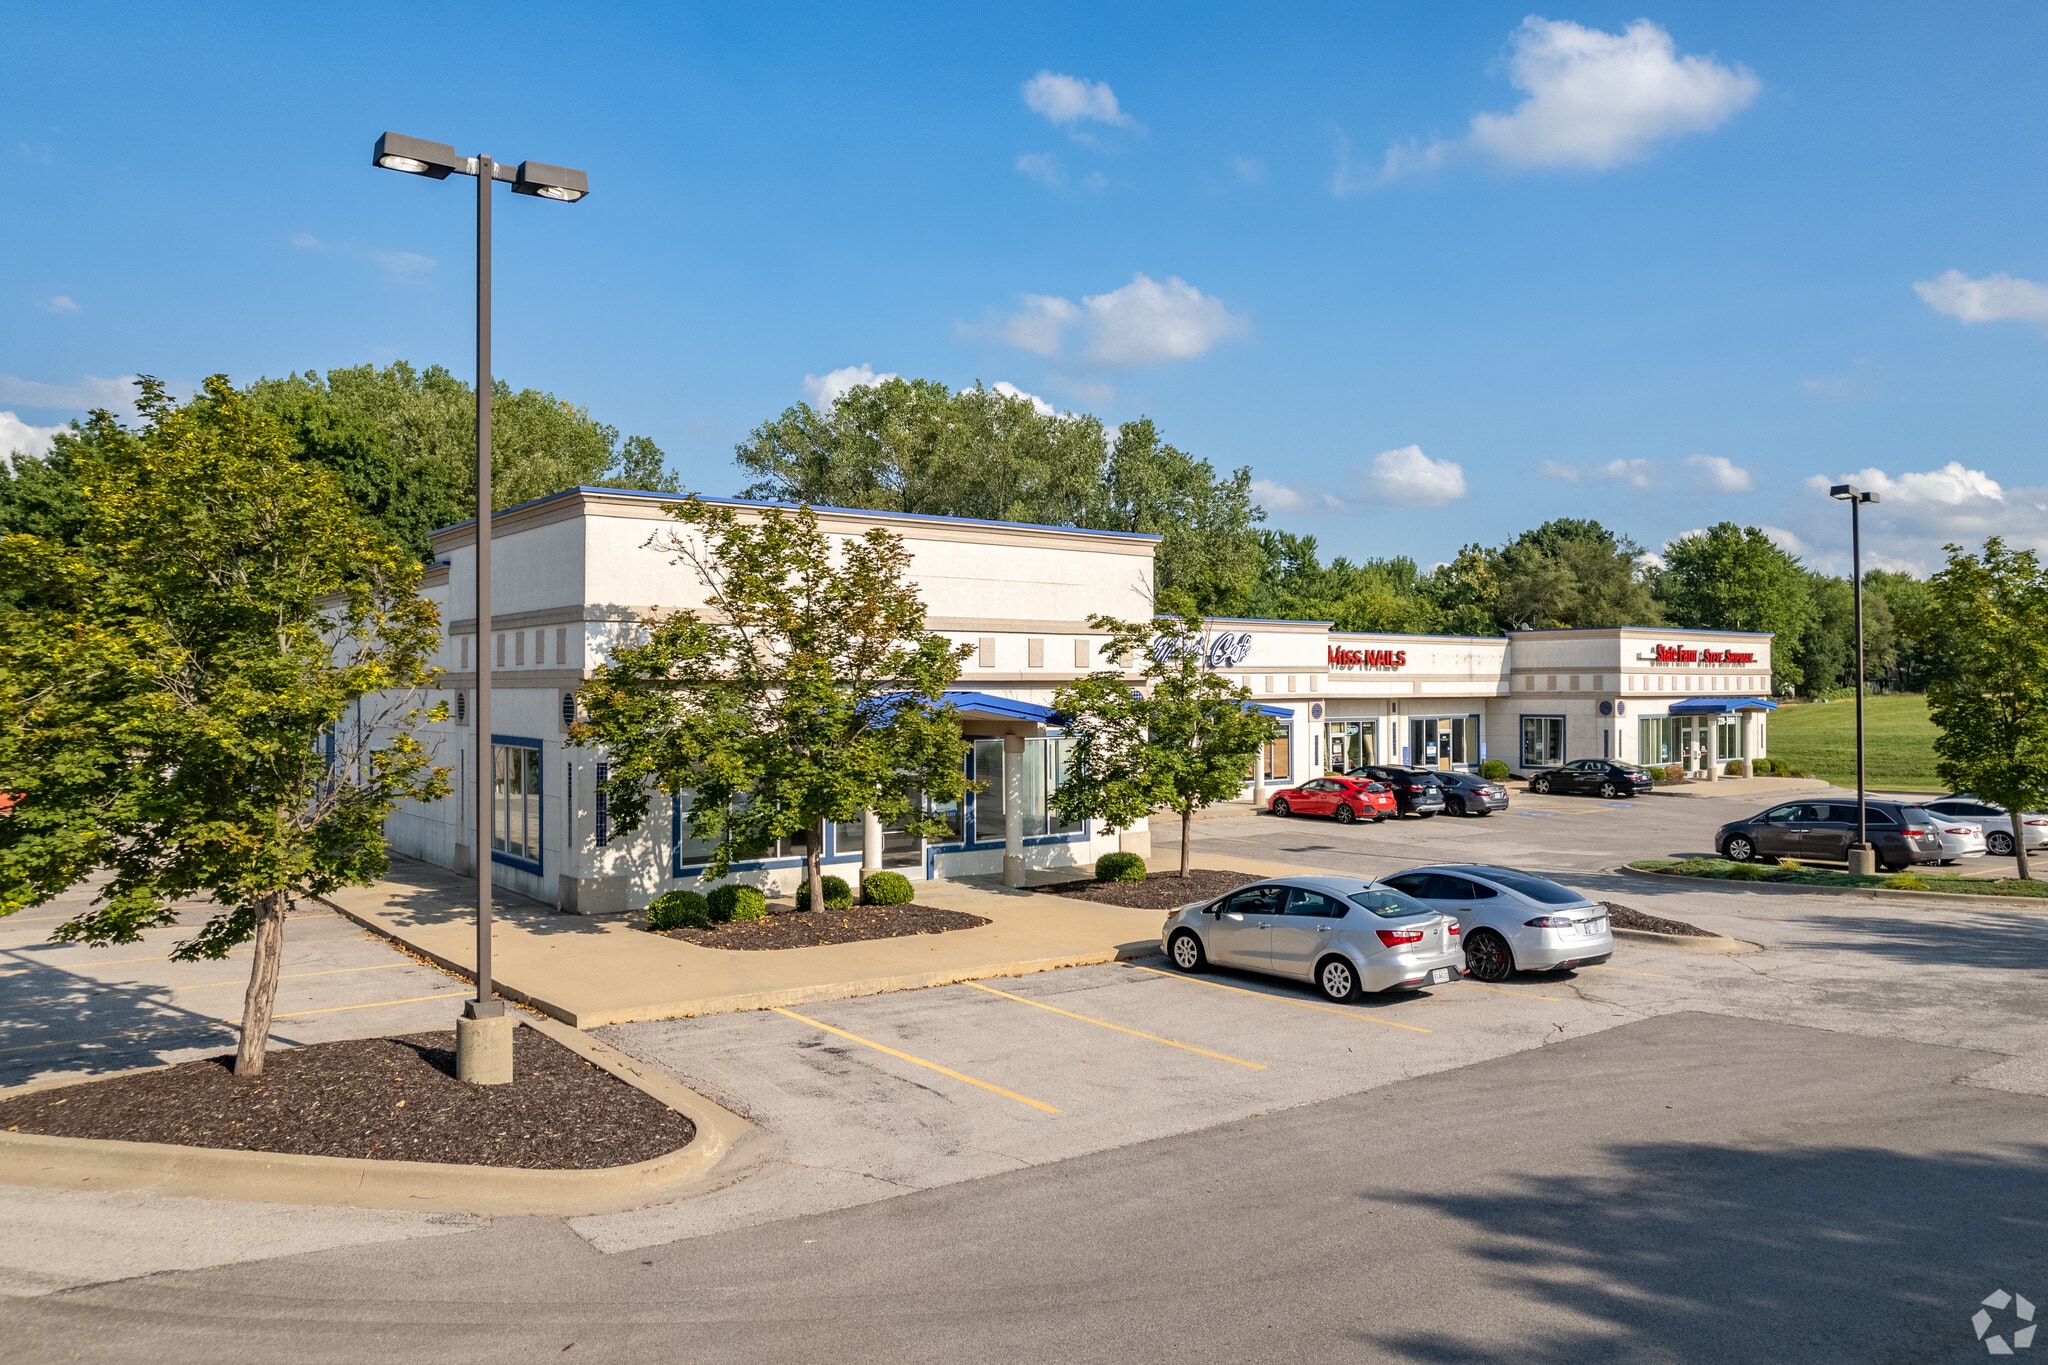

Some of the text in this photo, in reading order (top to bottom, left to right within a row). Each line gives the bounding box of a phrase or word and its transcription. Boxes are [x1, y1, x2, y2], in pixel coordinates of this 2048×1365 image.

[1328, 645, 1406, 667] MISS NAILS
[1656, 644, 1678, 662] State
[1677, 645, 1697, 662] Farm
